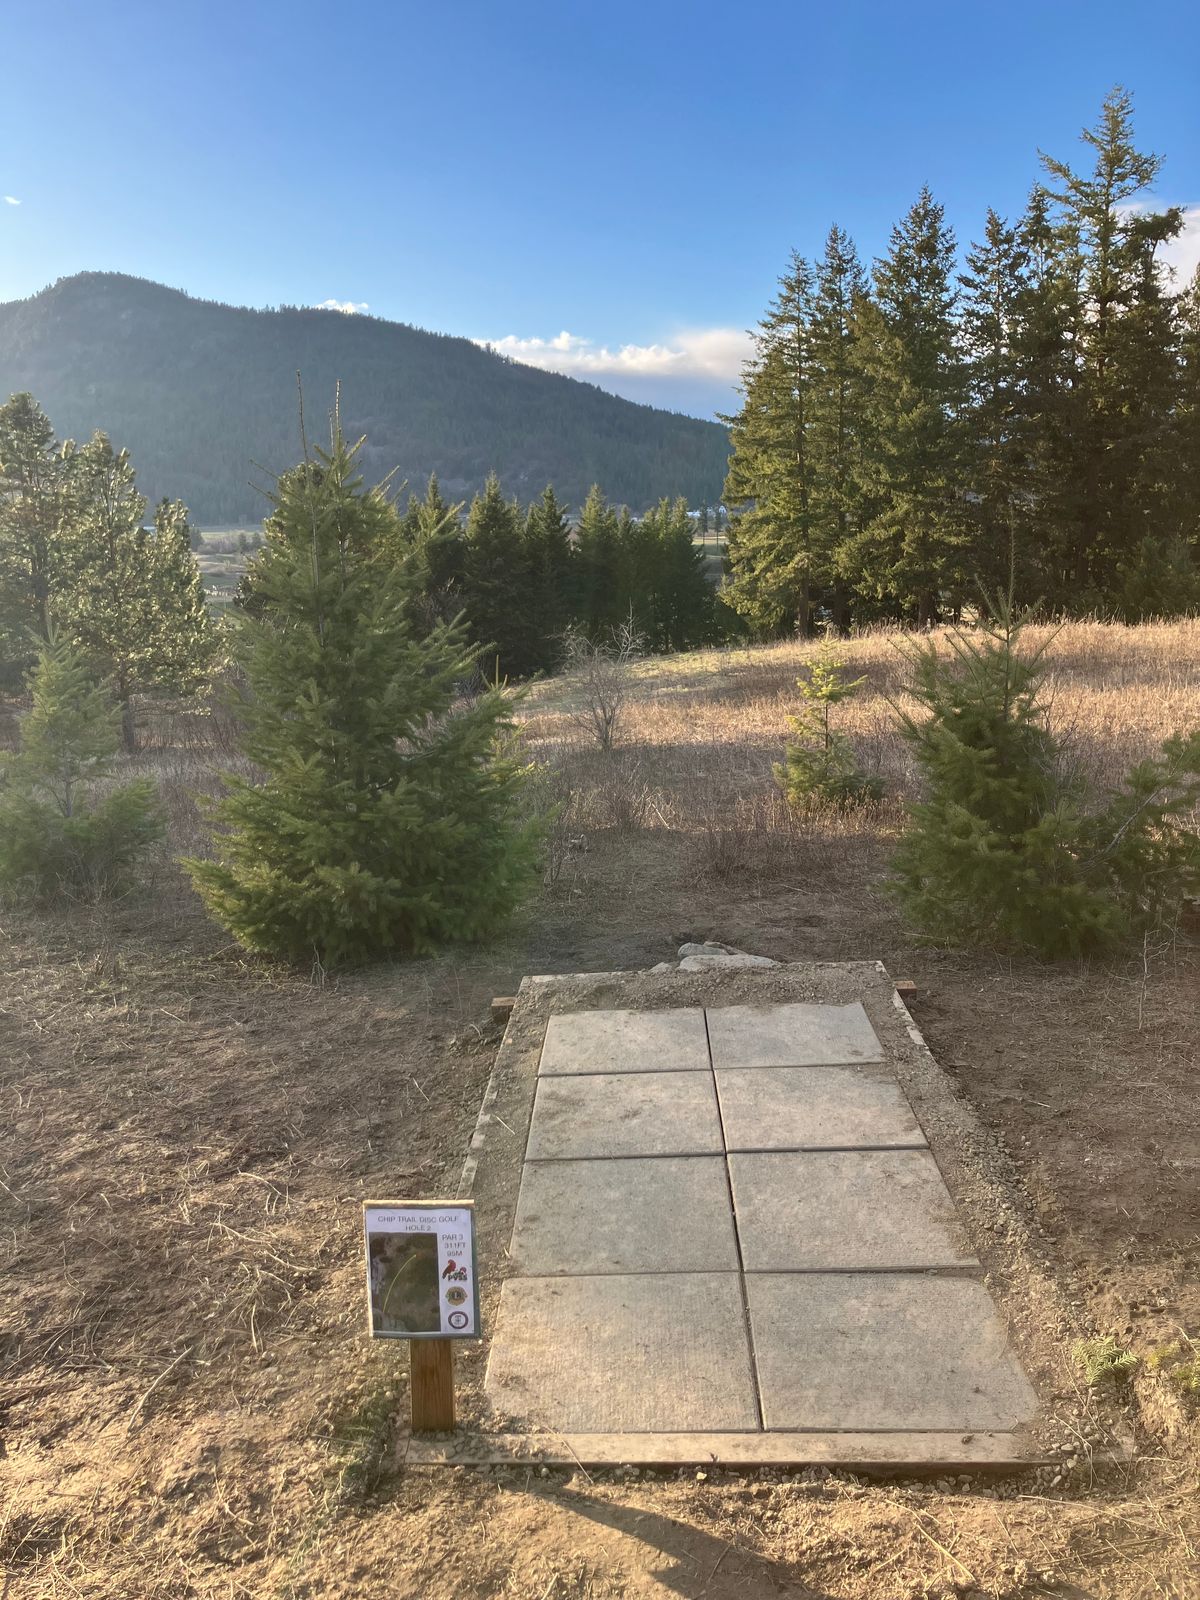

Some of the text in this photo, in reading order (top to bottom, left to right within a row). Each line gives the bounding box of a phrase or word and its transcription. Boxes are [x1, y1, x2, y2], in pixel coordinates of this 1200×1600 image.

[377, 1215, 396, 1223] CHIP
[398, 1215, 417, 1223] TRAIL
[438, 1215, 458, 1223] GOLF
